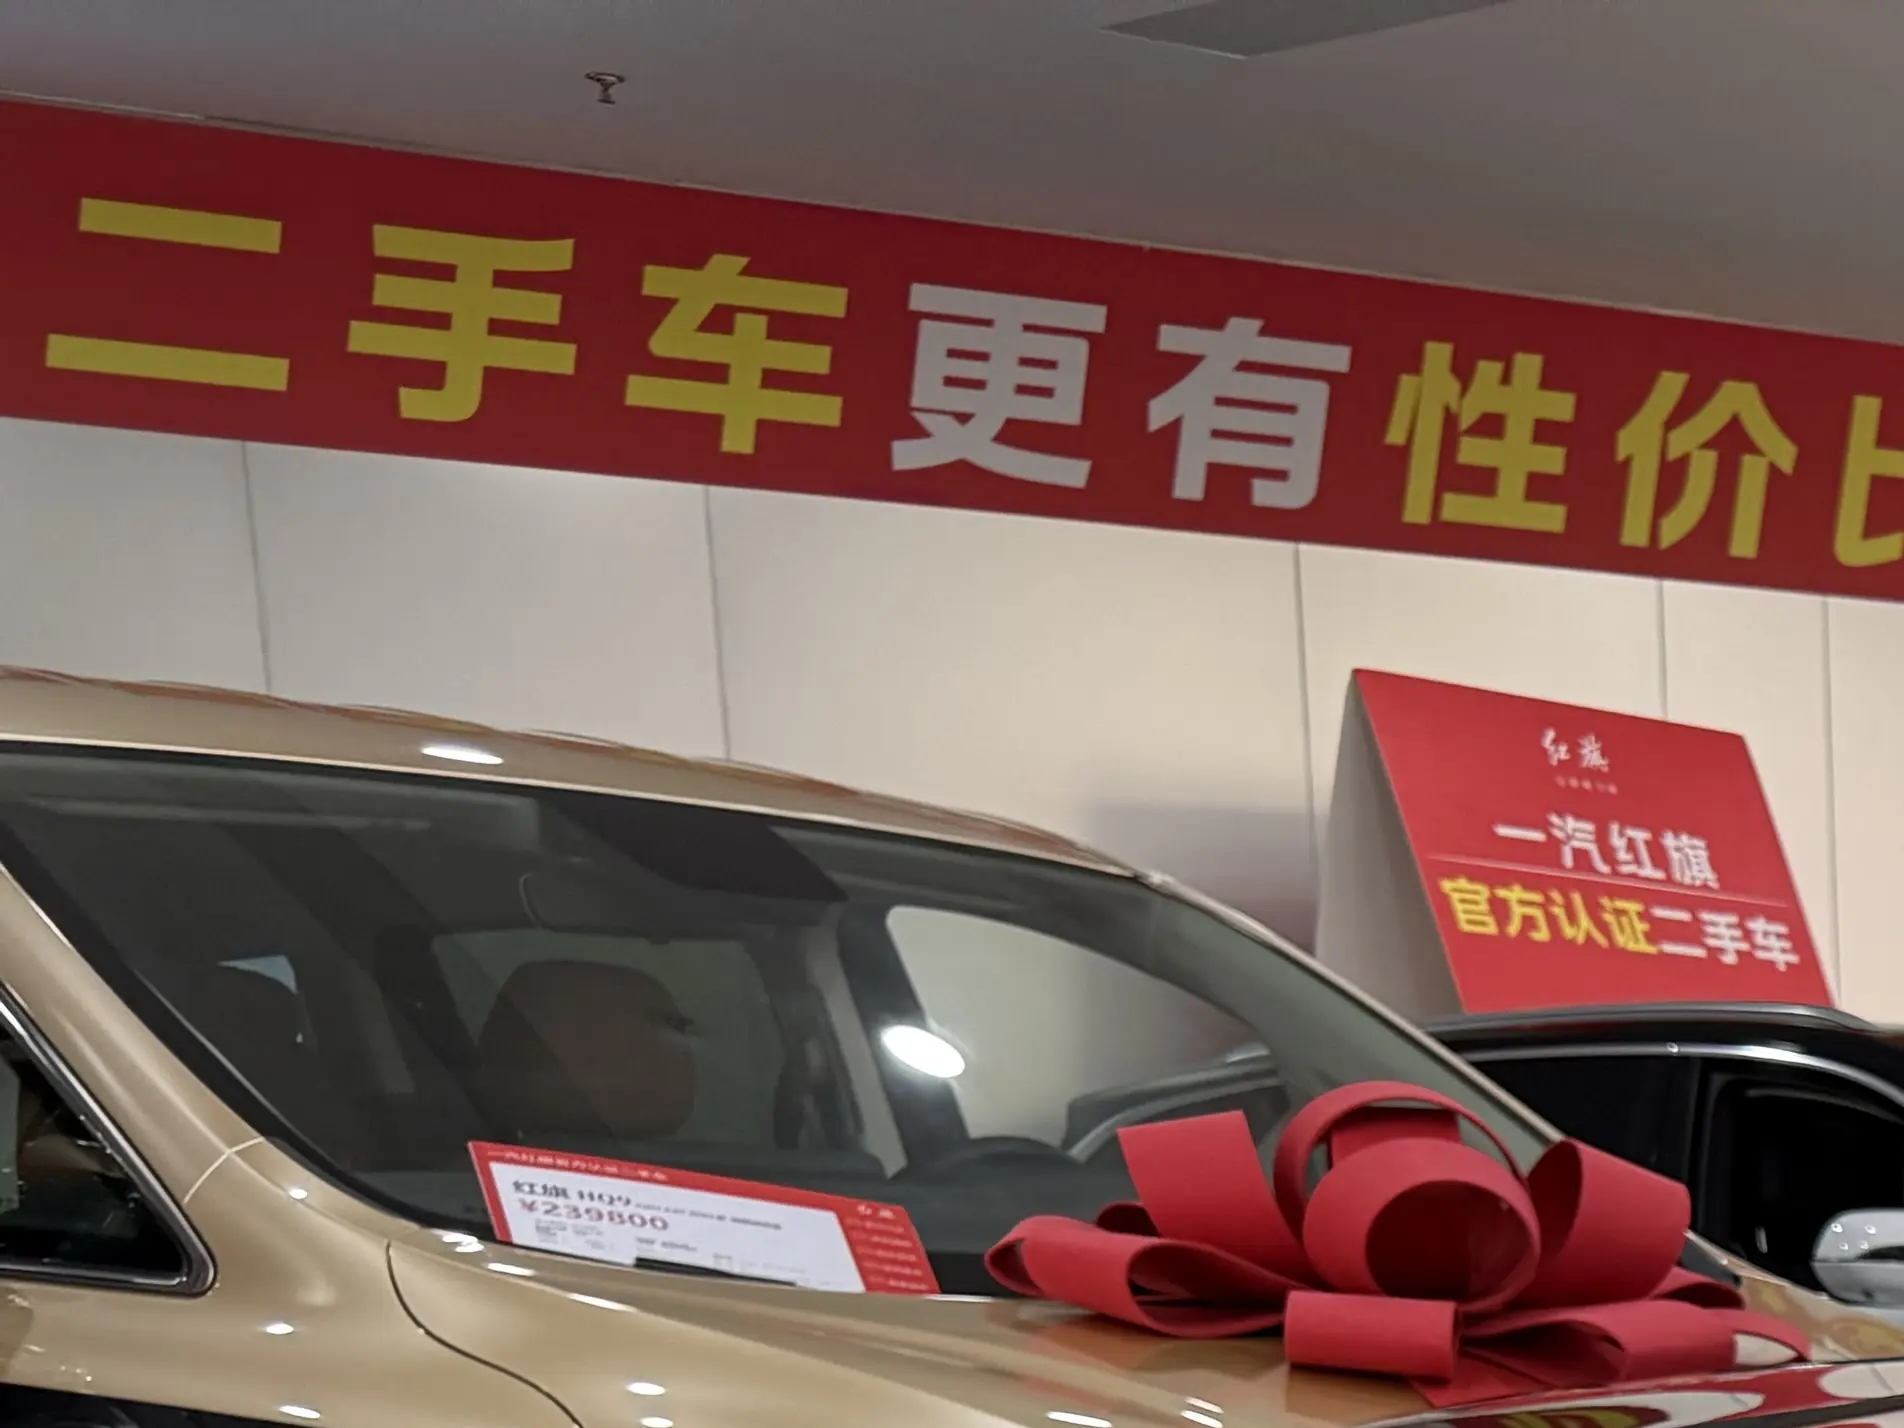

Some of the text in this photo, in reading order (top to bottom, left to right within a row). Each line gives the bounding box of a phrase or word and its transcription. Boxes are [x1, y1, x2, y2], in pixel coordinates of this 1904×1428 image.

[1493, 812, 1720, 889] 一汽红旗
[1438, 876, 1801, 972] 官方认证二手车
